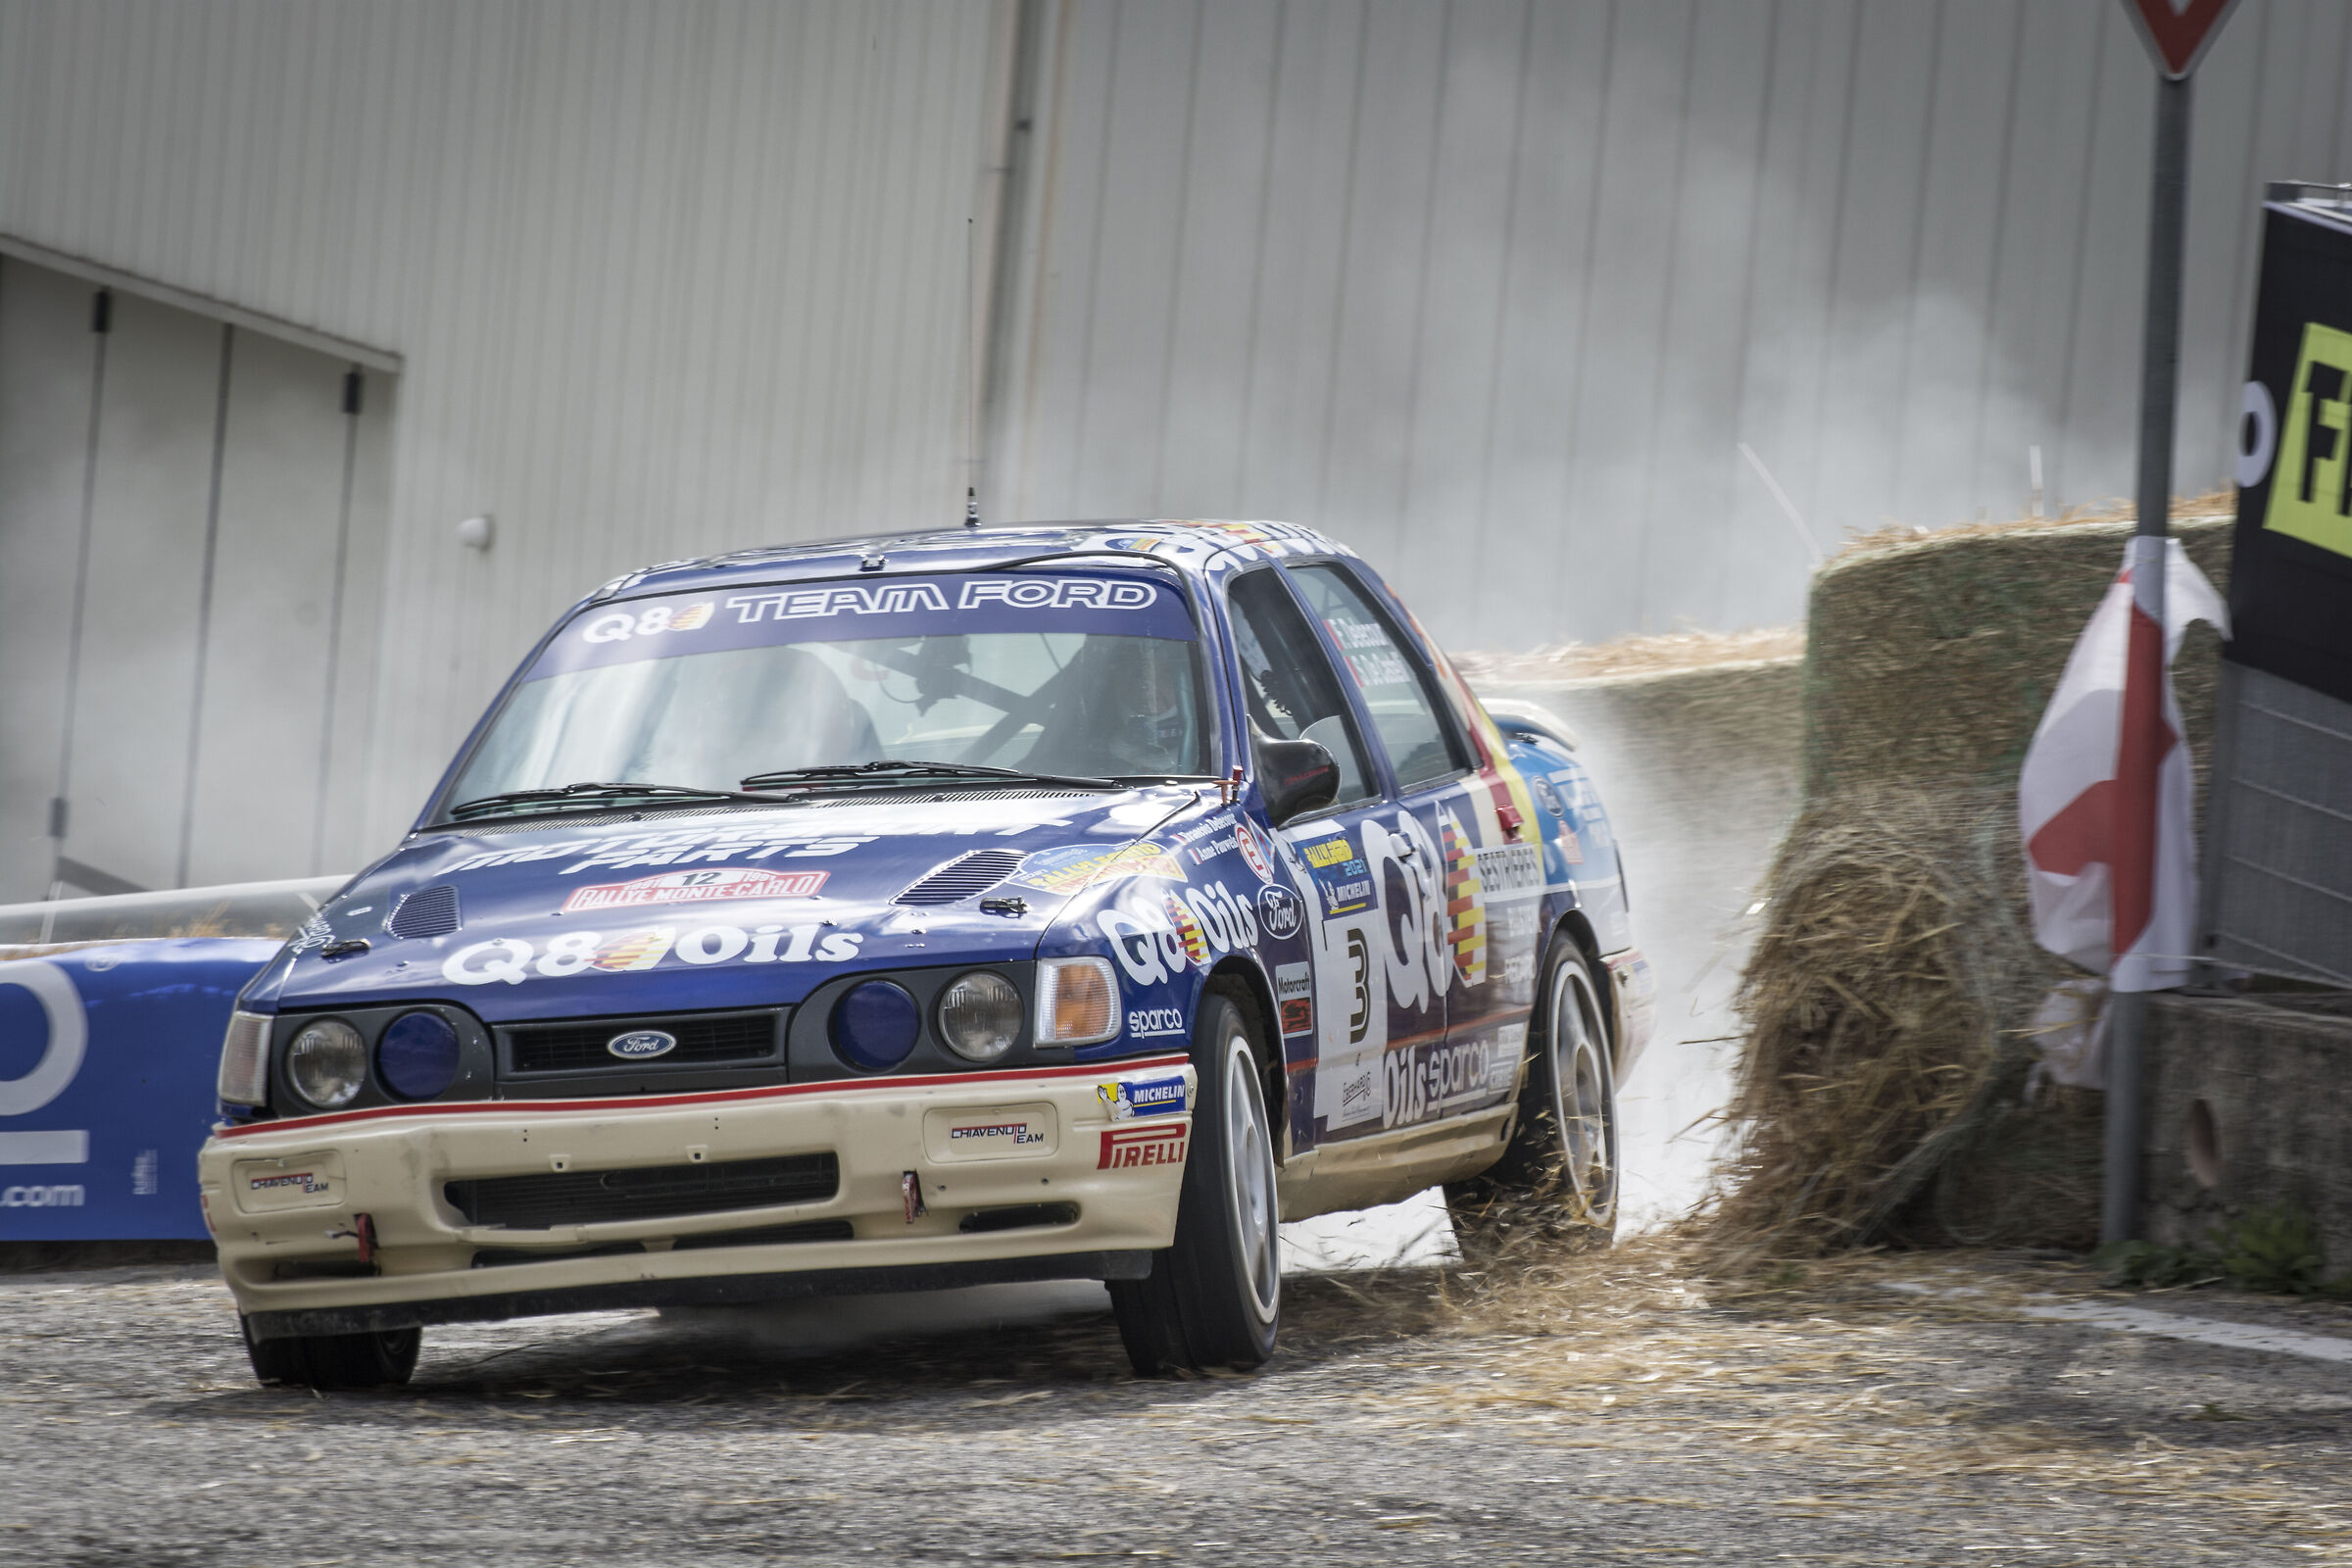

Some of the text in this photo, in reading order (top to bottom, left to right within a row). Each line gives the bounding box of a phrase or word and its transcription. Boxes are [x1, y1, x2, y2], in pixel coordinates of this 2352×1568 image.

[582, 579, 1158, 644] Q8 TEAM FORD
[558, 836, 881, 875] PARTS
[1343, 858, 1367, 877] 2021
[579, 875, 811, 907] RALLYE MONTE-CARLO
[681, 871, 722, 886] 12
[1185, 880, 1259, 954] Oils
[1262, 890, 1298, 931] Ford
[441, 924, 863, 986] Q8 Oils
[1347, 927, 1370, 1045] 3
[1129, 1006, 1183, 1039] sparco
[623, 1036, 661, 1053] Ford
[1134, 1085, 1185, 1102] MICHELIN
[1383, 1039, 1490, 1130] Oils sparco
[1097, 1123, 1187, 1170] PIRELLI
